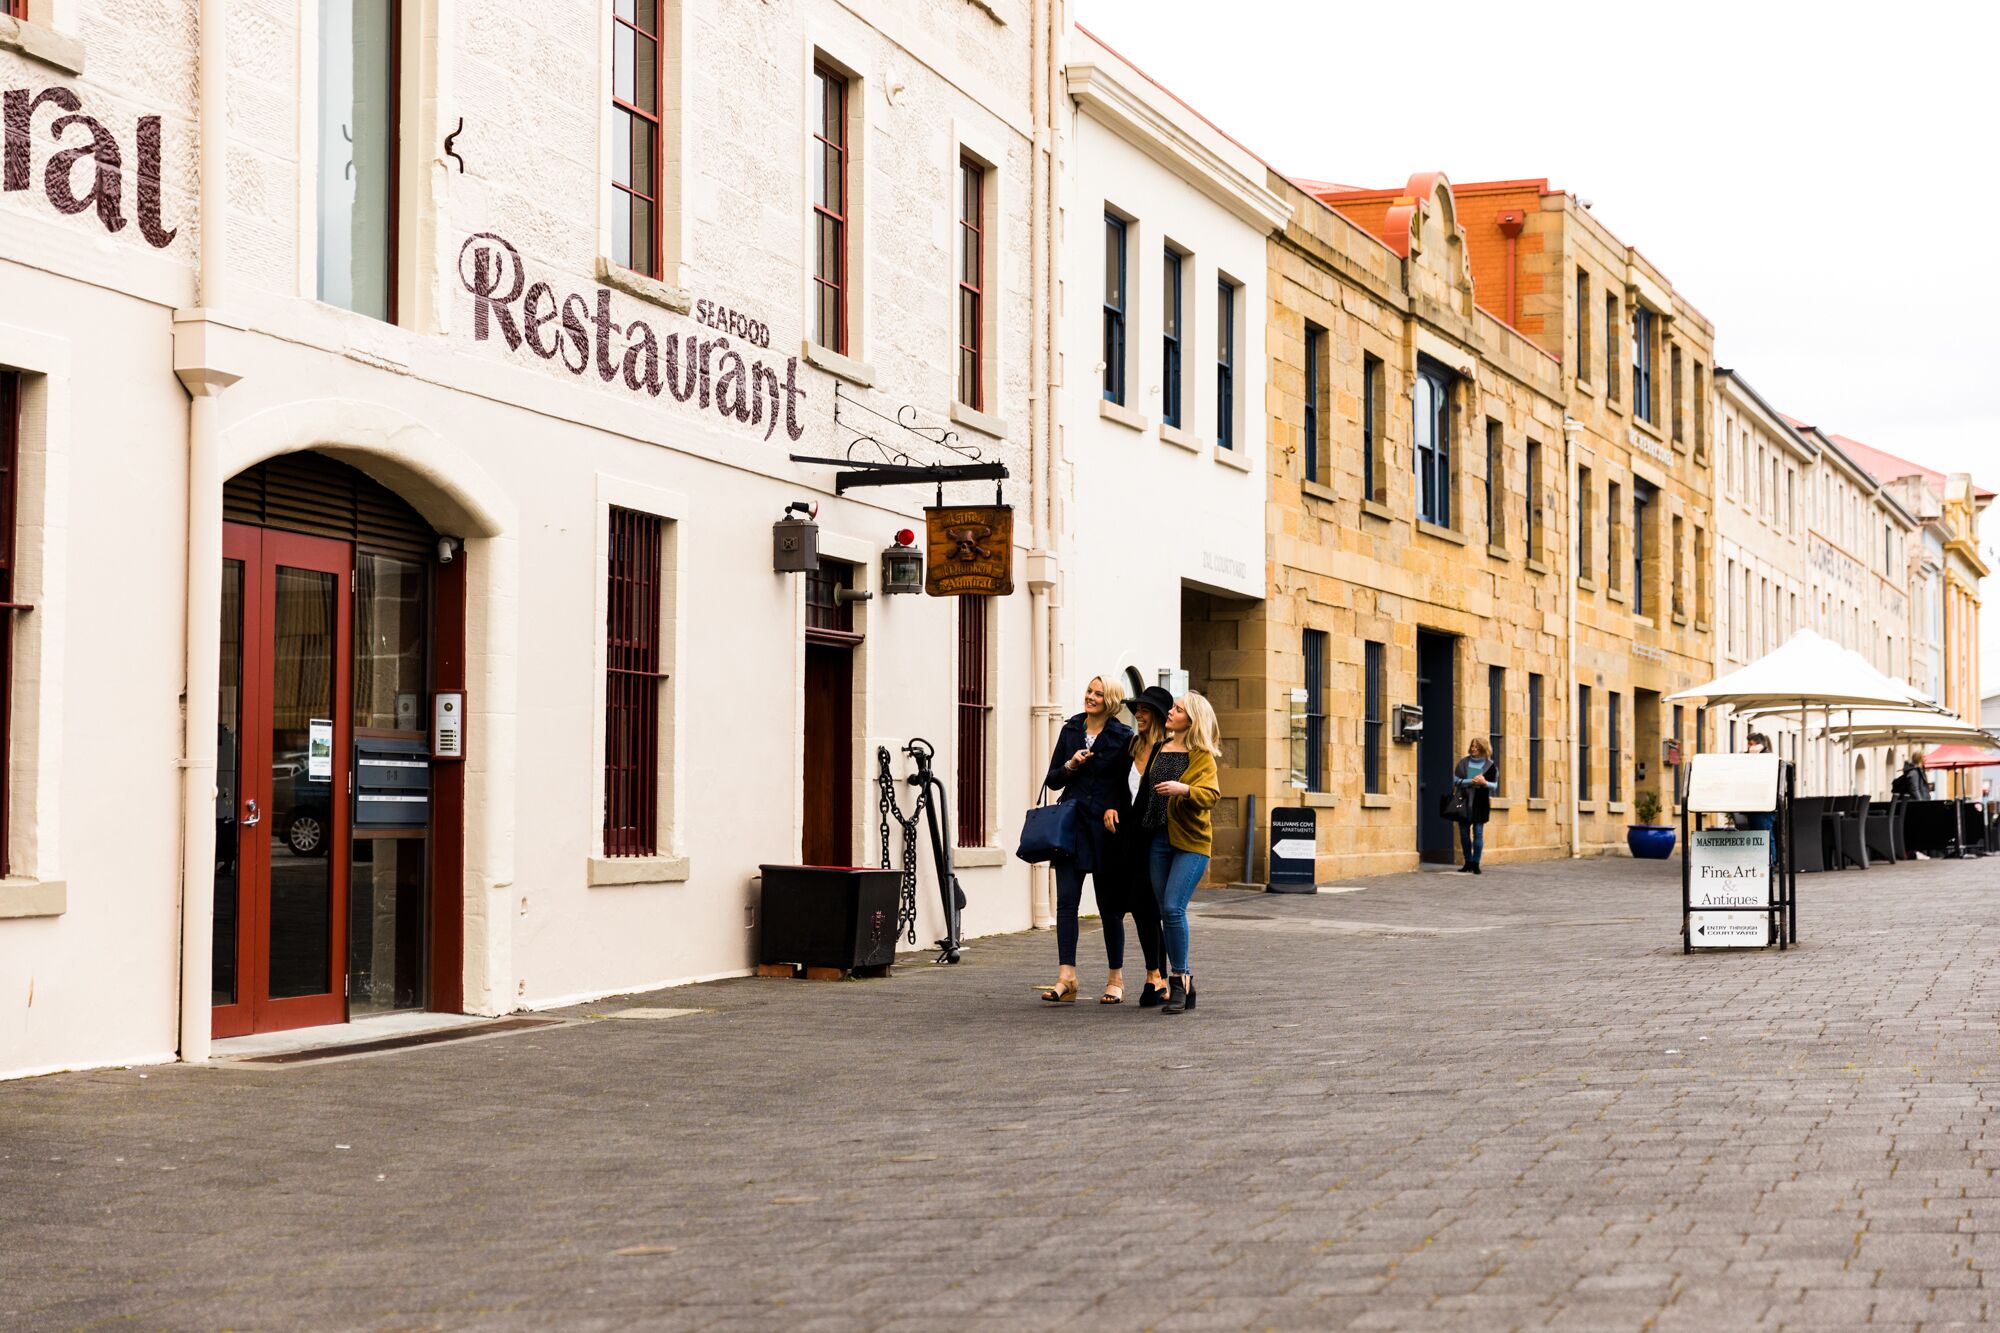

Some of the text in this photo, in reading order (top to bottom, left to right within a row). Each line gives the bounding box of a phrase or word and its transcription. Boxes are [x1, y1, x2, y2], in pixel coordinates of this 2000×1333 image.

[696, 298, 770, 348] SEAFOOD
[458, 231, 806, 441] Restaurant
[1696, 837, 1764, 847] MASTERPIECE @ IXL
[1701, 865, 1757, 879] Fine Art
[1722, 879, 1738, 893] &
[1701, 893, 1758, 907] Antiques
